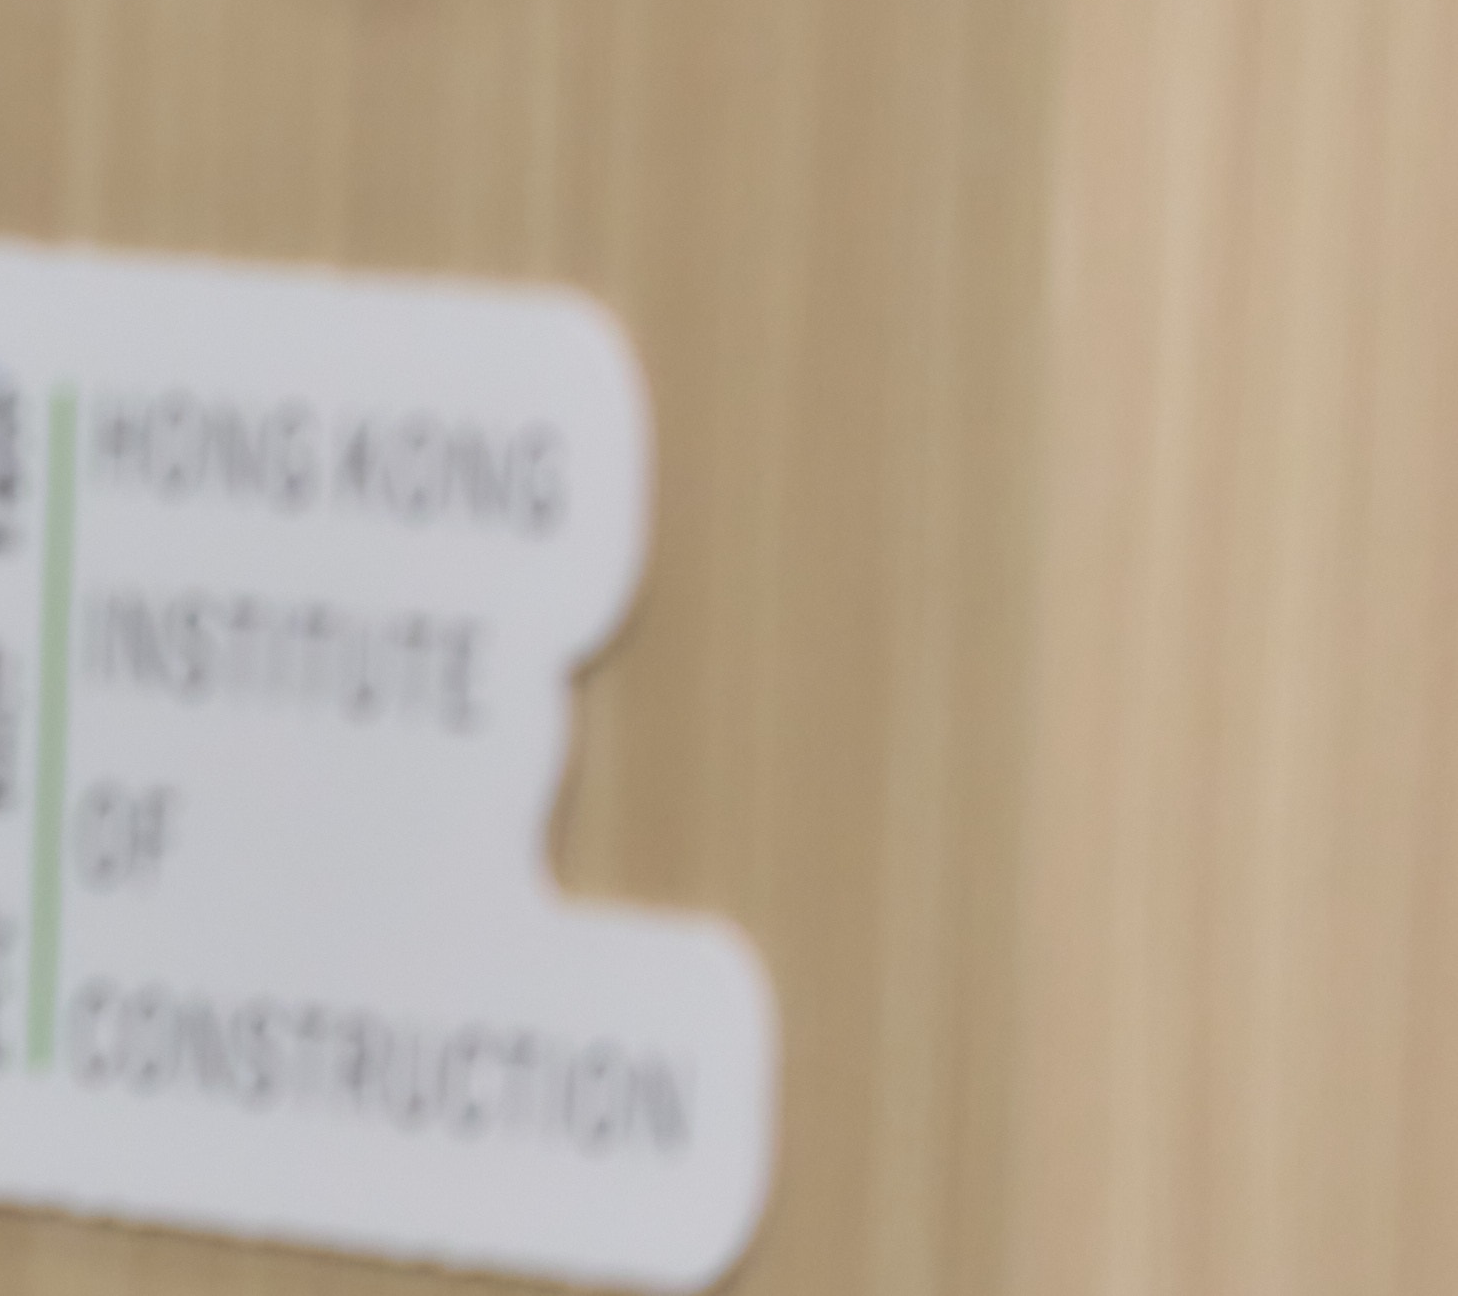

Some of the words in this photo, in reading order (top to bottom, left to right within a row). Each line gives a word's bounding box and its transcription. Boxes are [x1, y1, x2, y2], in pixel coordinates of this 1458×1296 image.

[90, 385, 322, 519] HONG
[330, 407, 570, 541] KONG
[80, 591, 490, 739] INSTITUTE
[74, 776, 178, 893] OF
[64, 974, 698, 1159] CONSTRUCTION
